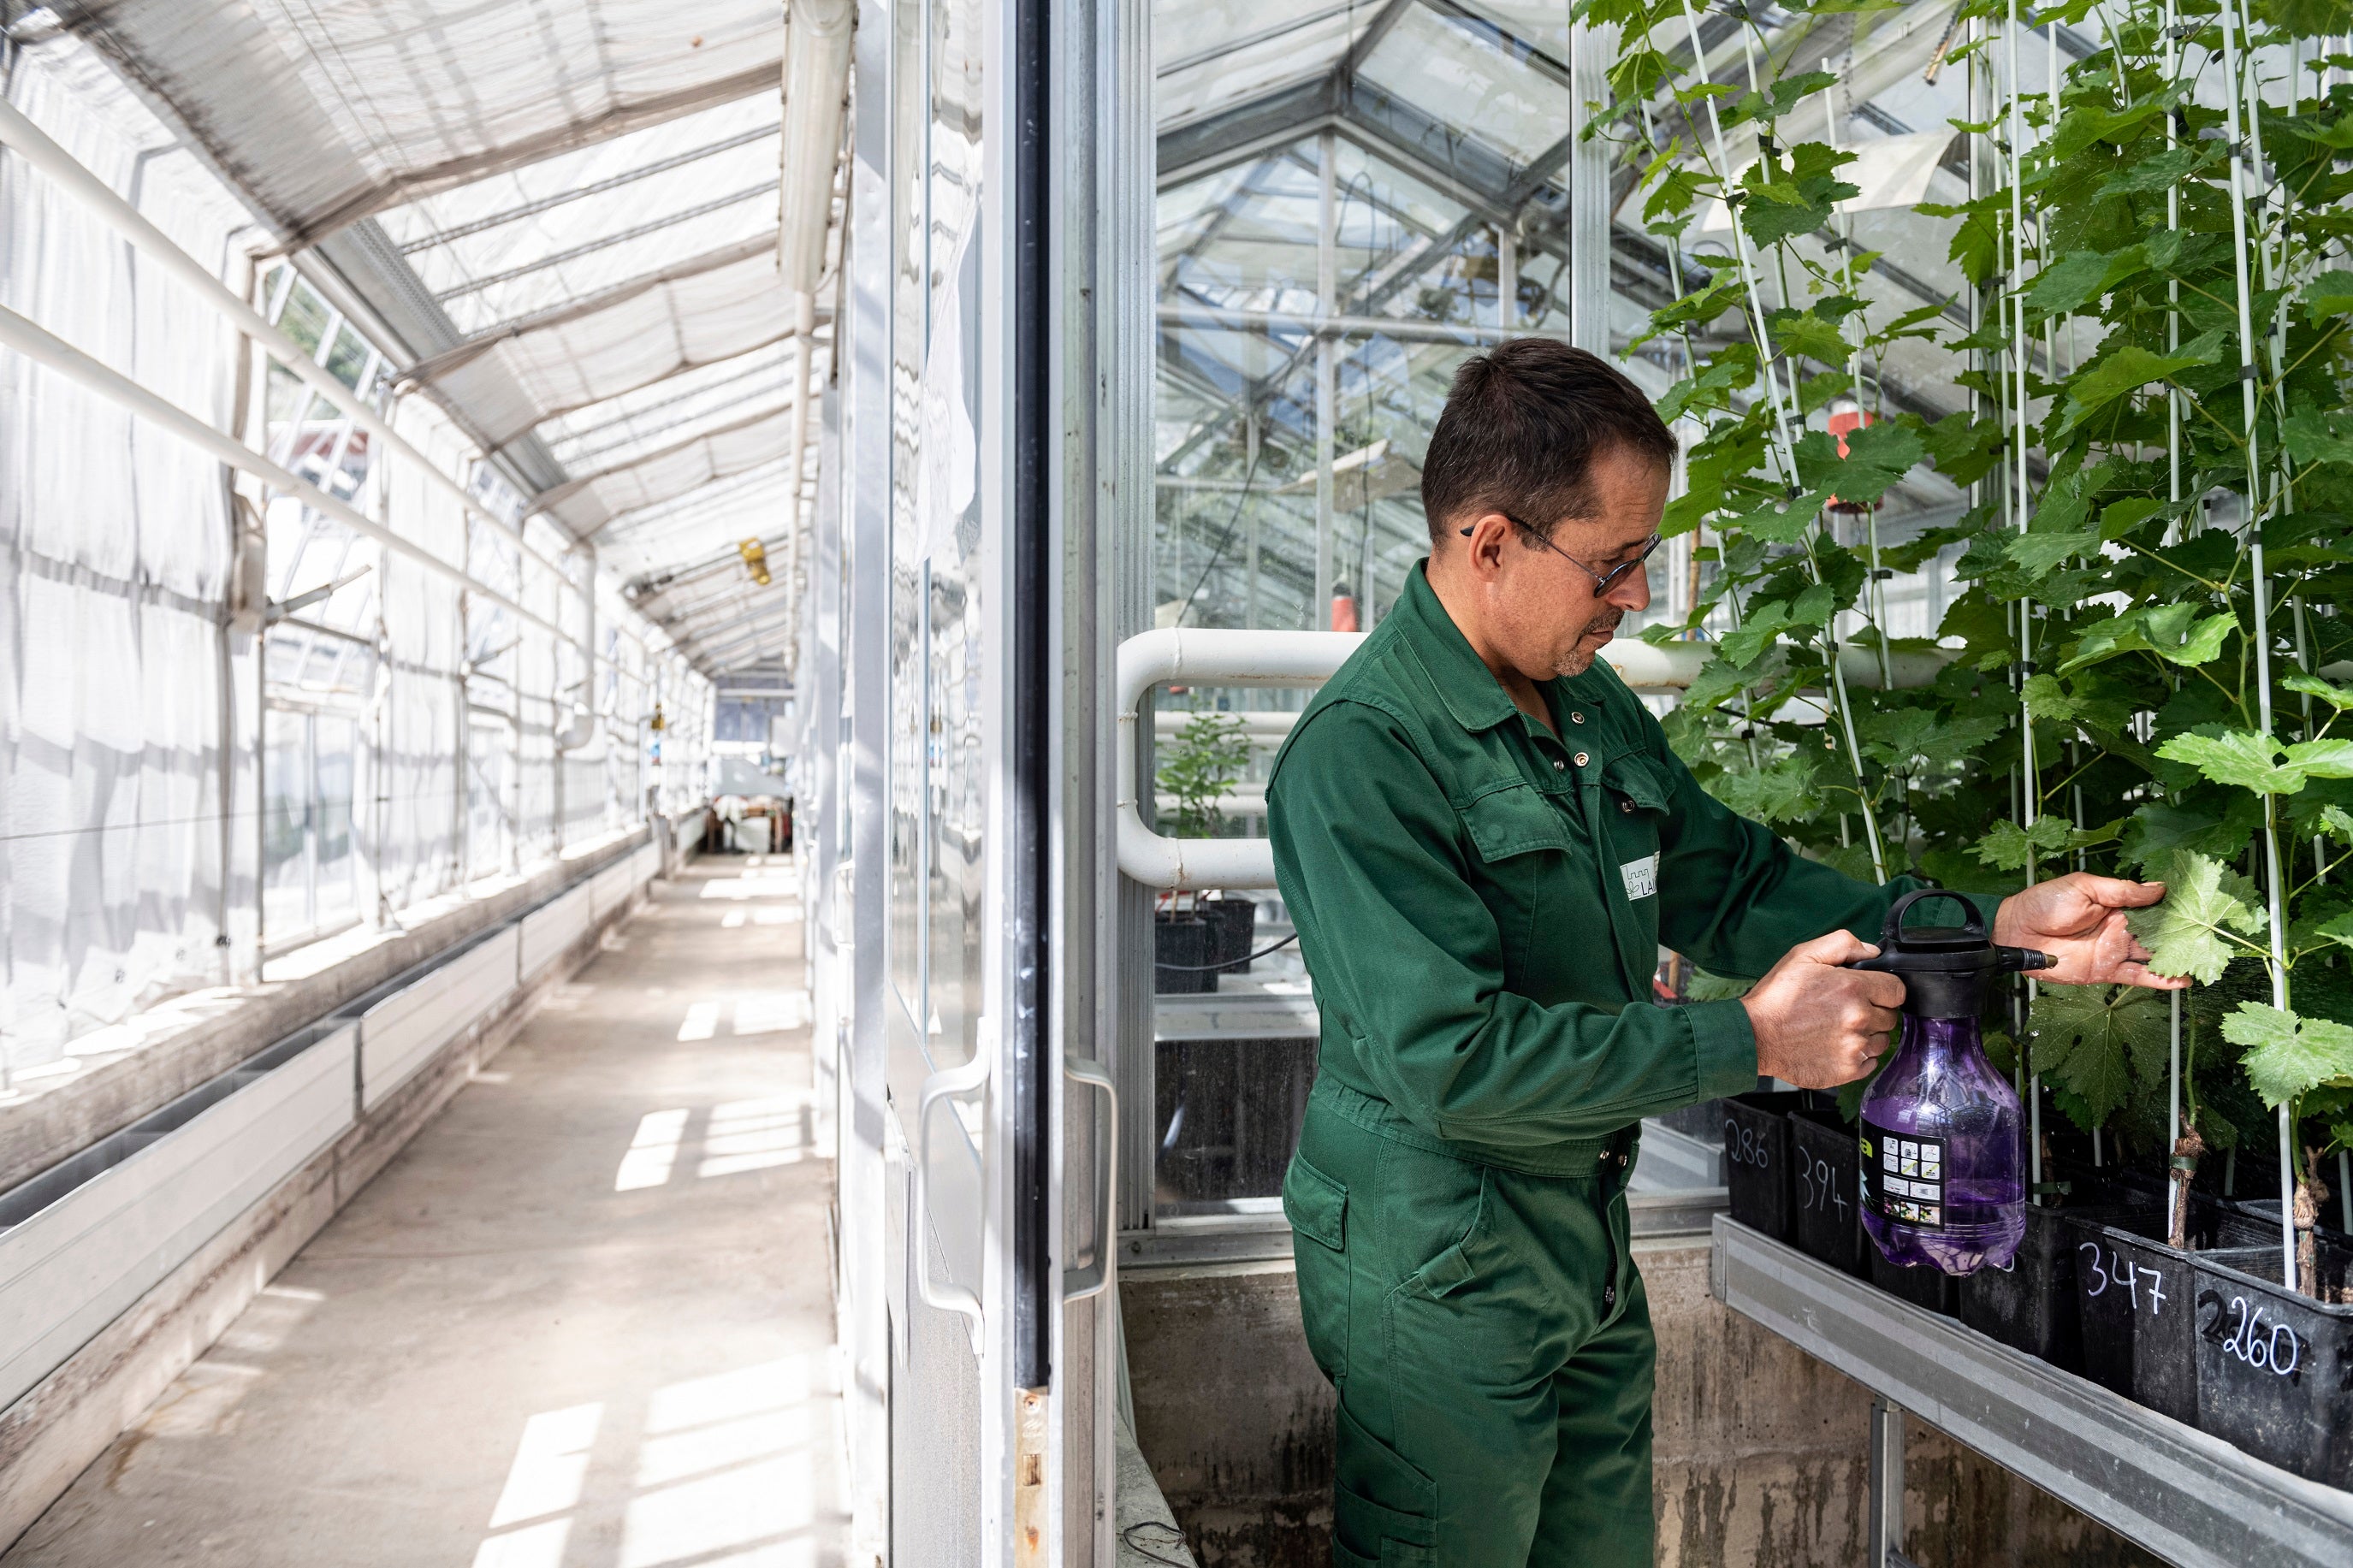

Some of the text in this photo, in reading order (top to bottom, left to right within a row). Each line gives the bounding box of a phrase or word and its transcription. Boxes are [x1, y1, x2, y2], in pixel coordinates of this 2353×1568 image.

[1725, 1118, 1769, 1169] 286
[1799, 1145, 1849, 1223] 394
[2079, 1241, 2166, 1315] 347
[2223, 1296, 2297, 1375] 260
